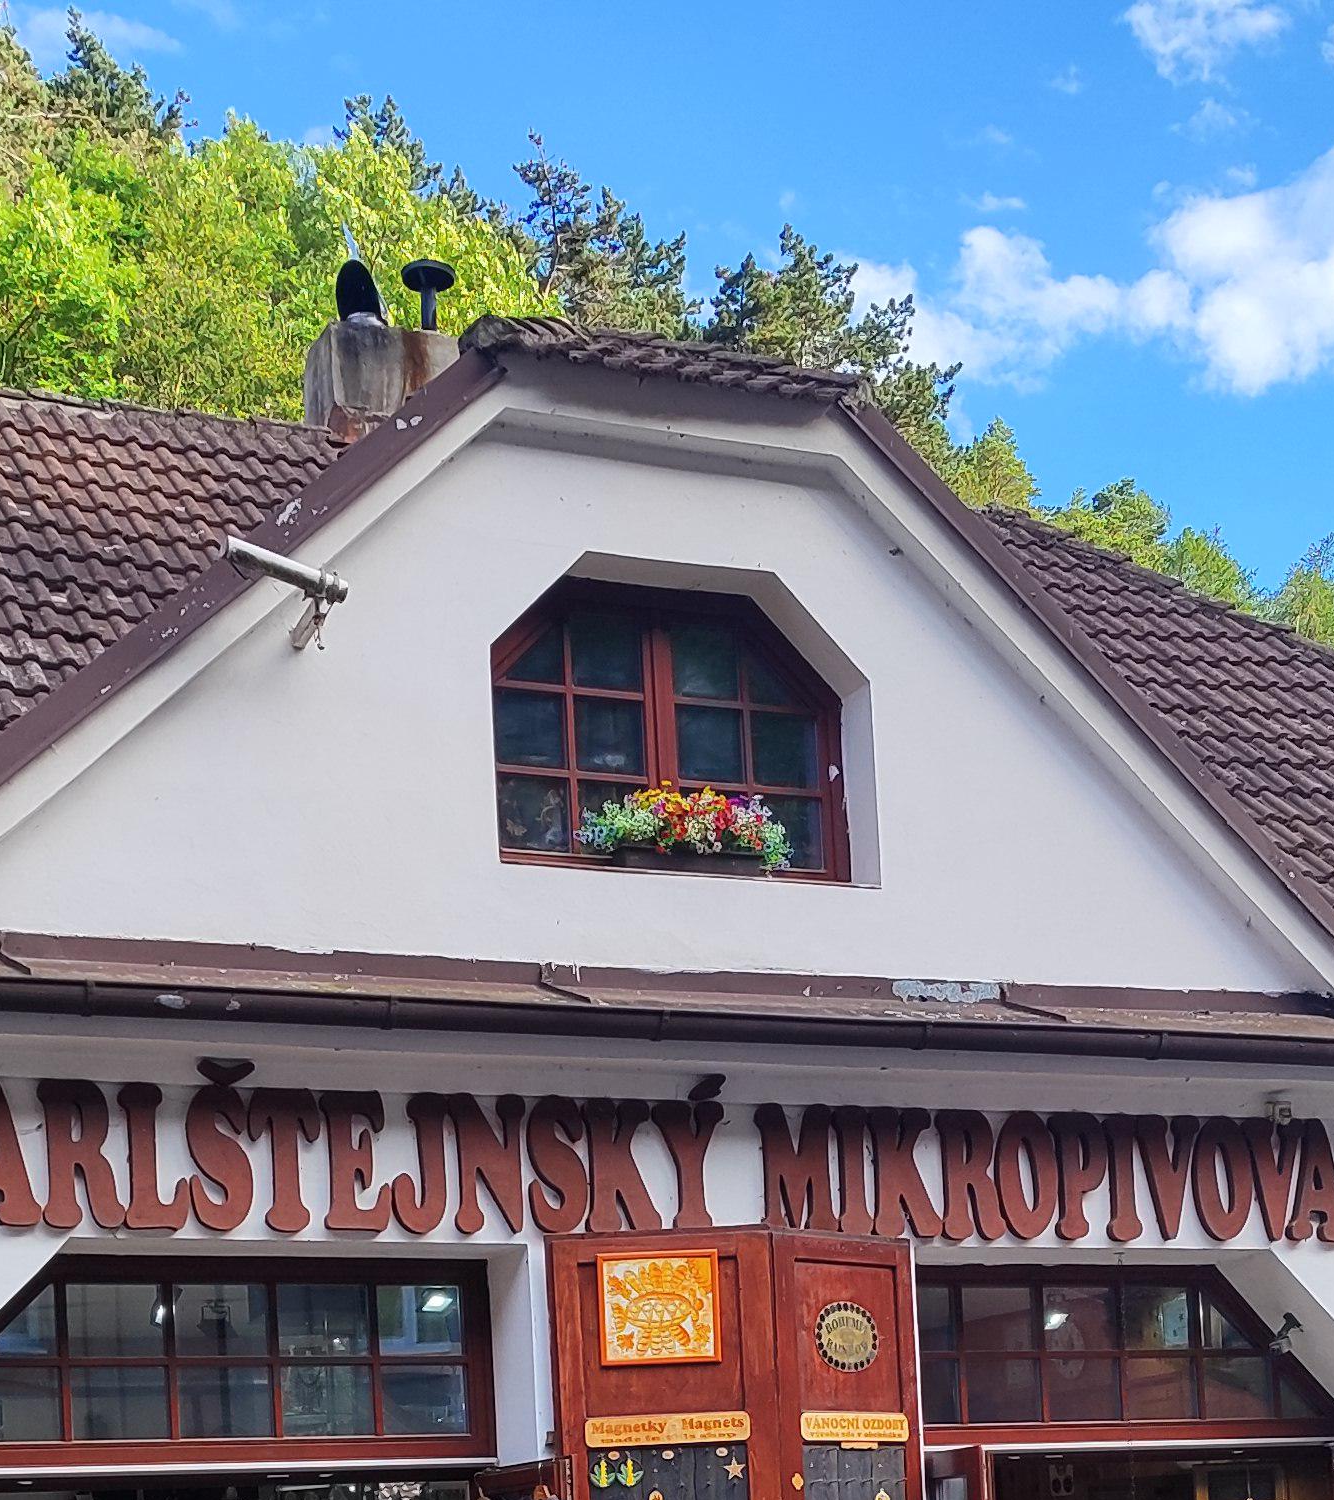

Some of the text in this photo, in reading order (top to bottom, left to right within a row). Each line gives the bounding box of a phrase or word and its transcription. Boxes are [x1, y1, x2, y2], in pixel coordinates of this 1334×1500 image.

[591, 1420, 667, 1437] Magnetky
[681, 1417, 745, 1431] Magnets
[862, 1418, 905, 1431] OZDOBY
